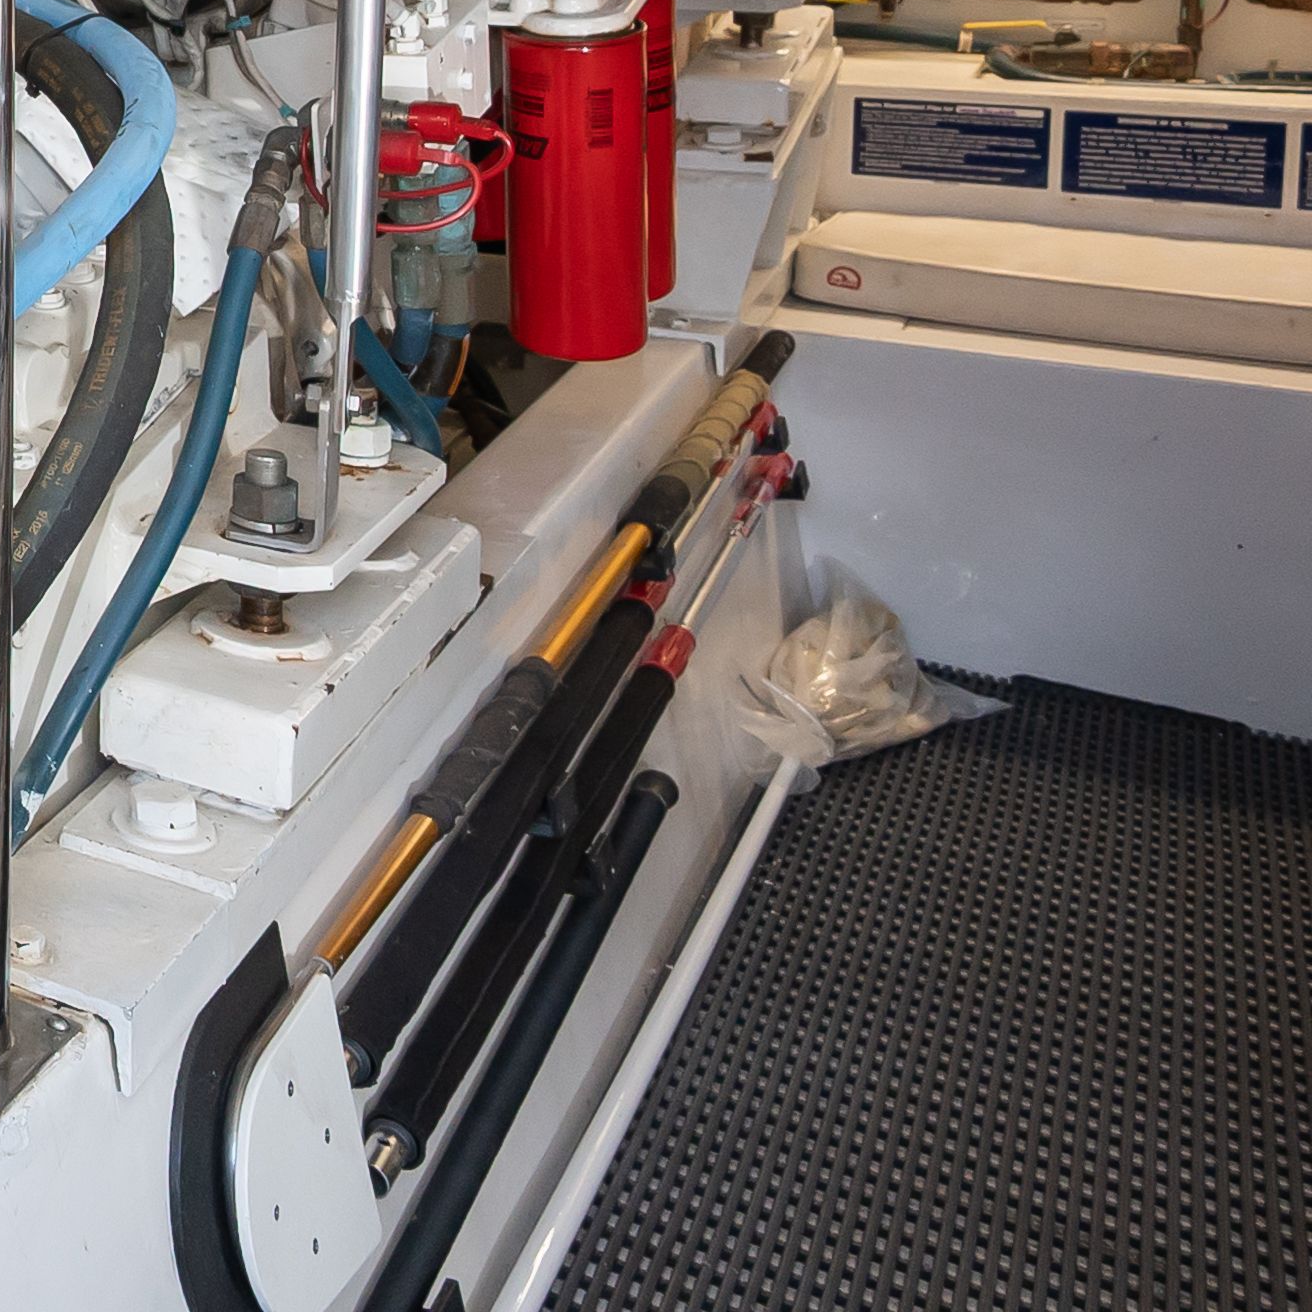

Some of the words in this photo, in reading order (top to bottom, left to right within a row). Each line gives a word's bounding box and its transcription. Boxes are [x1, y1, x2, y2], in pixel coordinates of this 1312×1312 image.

[87, 287, 128, 393] TRIDENT-FLEX
[13, 541, 30, 564] (E2)
[29, 510, 49, 535] 2016
